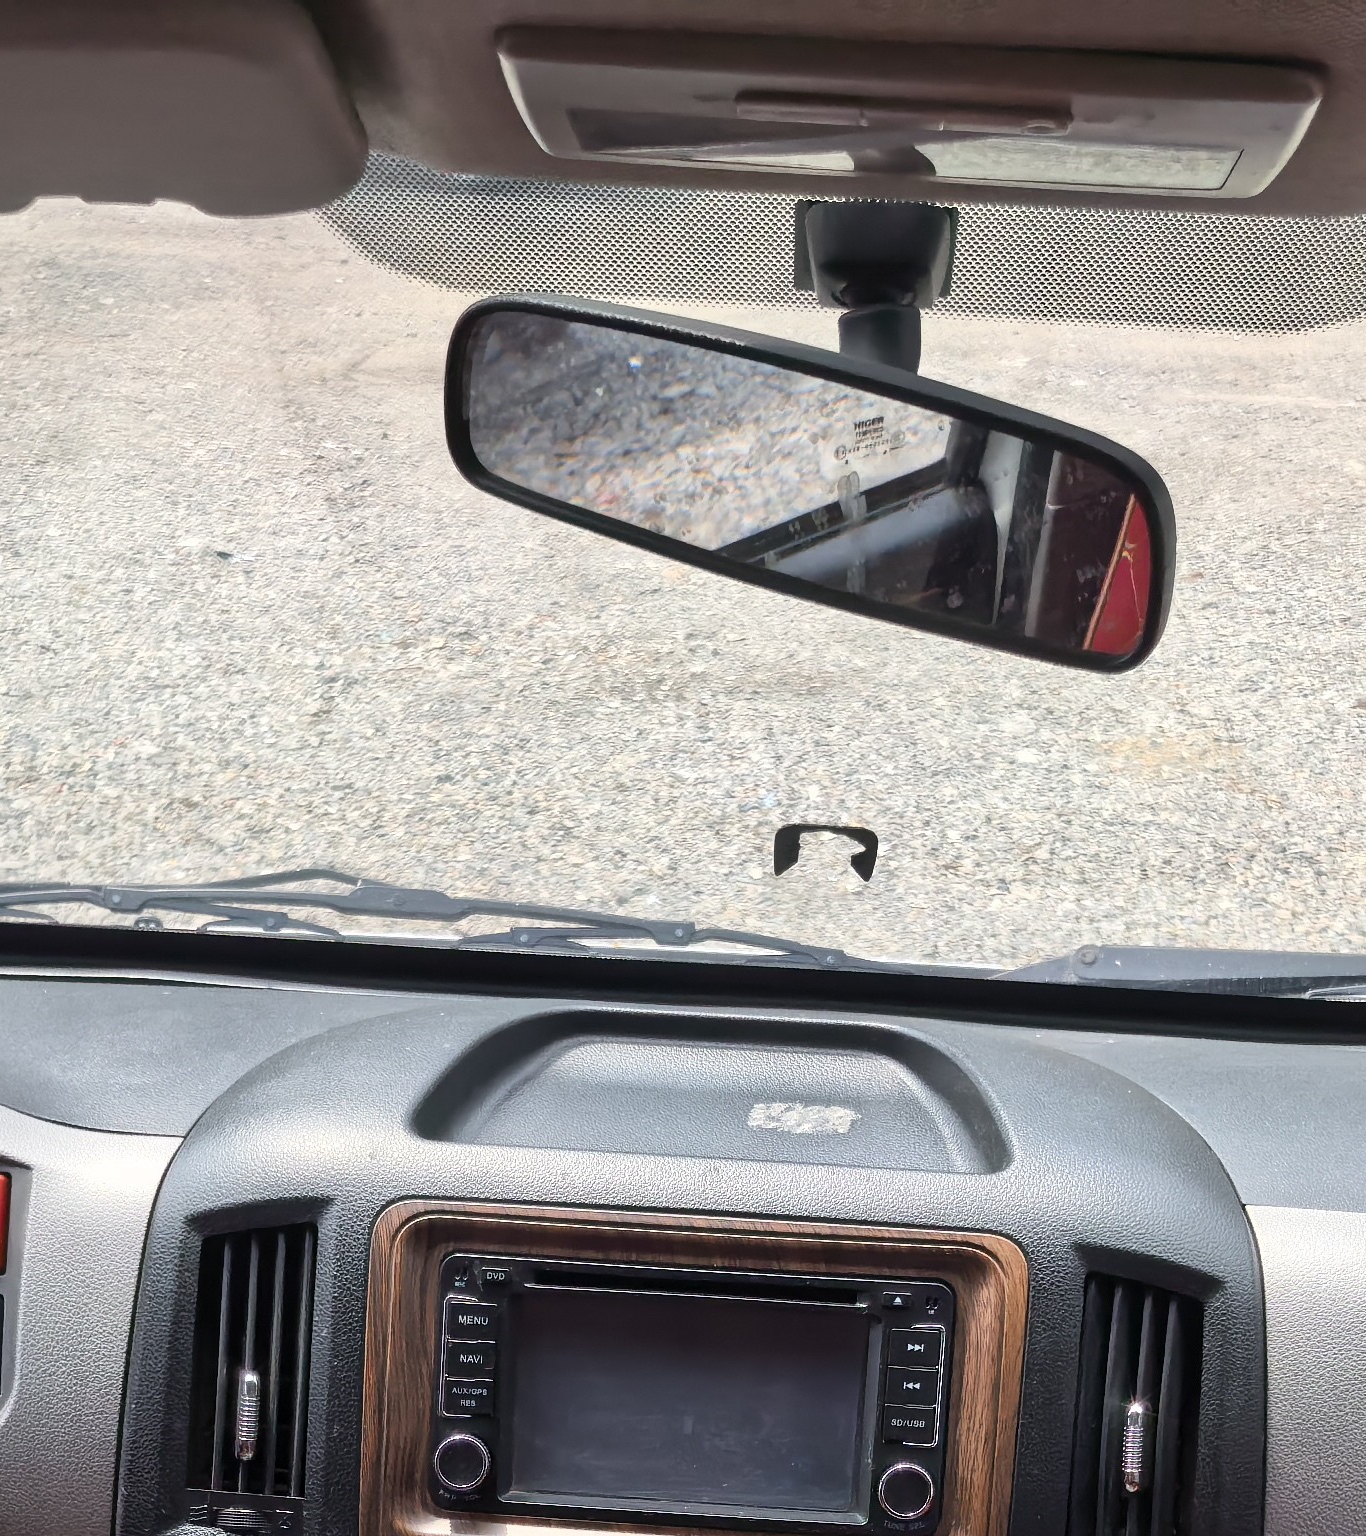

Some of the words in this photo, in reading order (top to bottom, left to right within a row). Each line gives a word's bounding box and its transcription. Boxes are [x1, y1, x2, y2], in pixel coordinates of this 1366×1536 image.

[486, 1271, 505, 1281] DVD
[458, 1314, 489, 1326] MENU
[459, 1353, 483, 1365] NAVI
[451, 1386, 488, 1396] AUX/GPS
[890, 1418, 926, 1428] SD/USB
